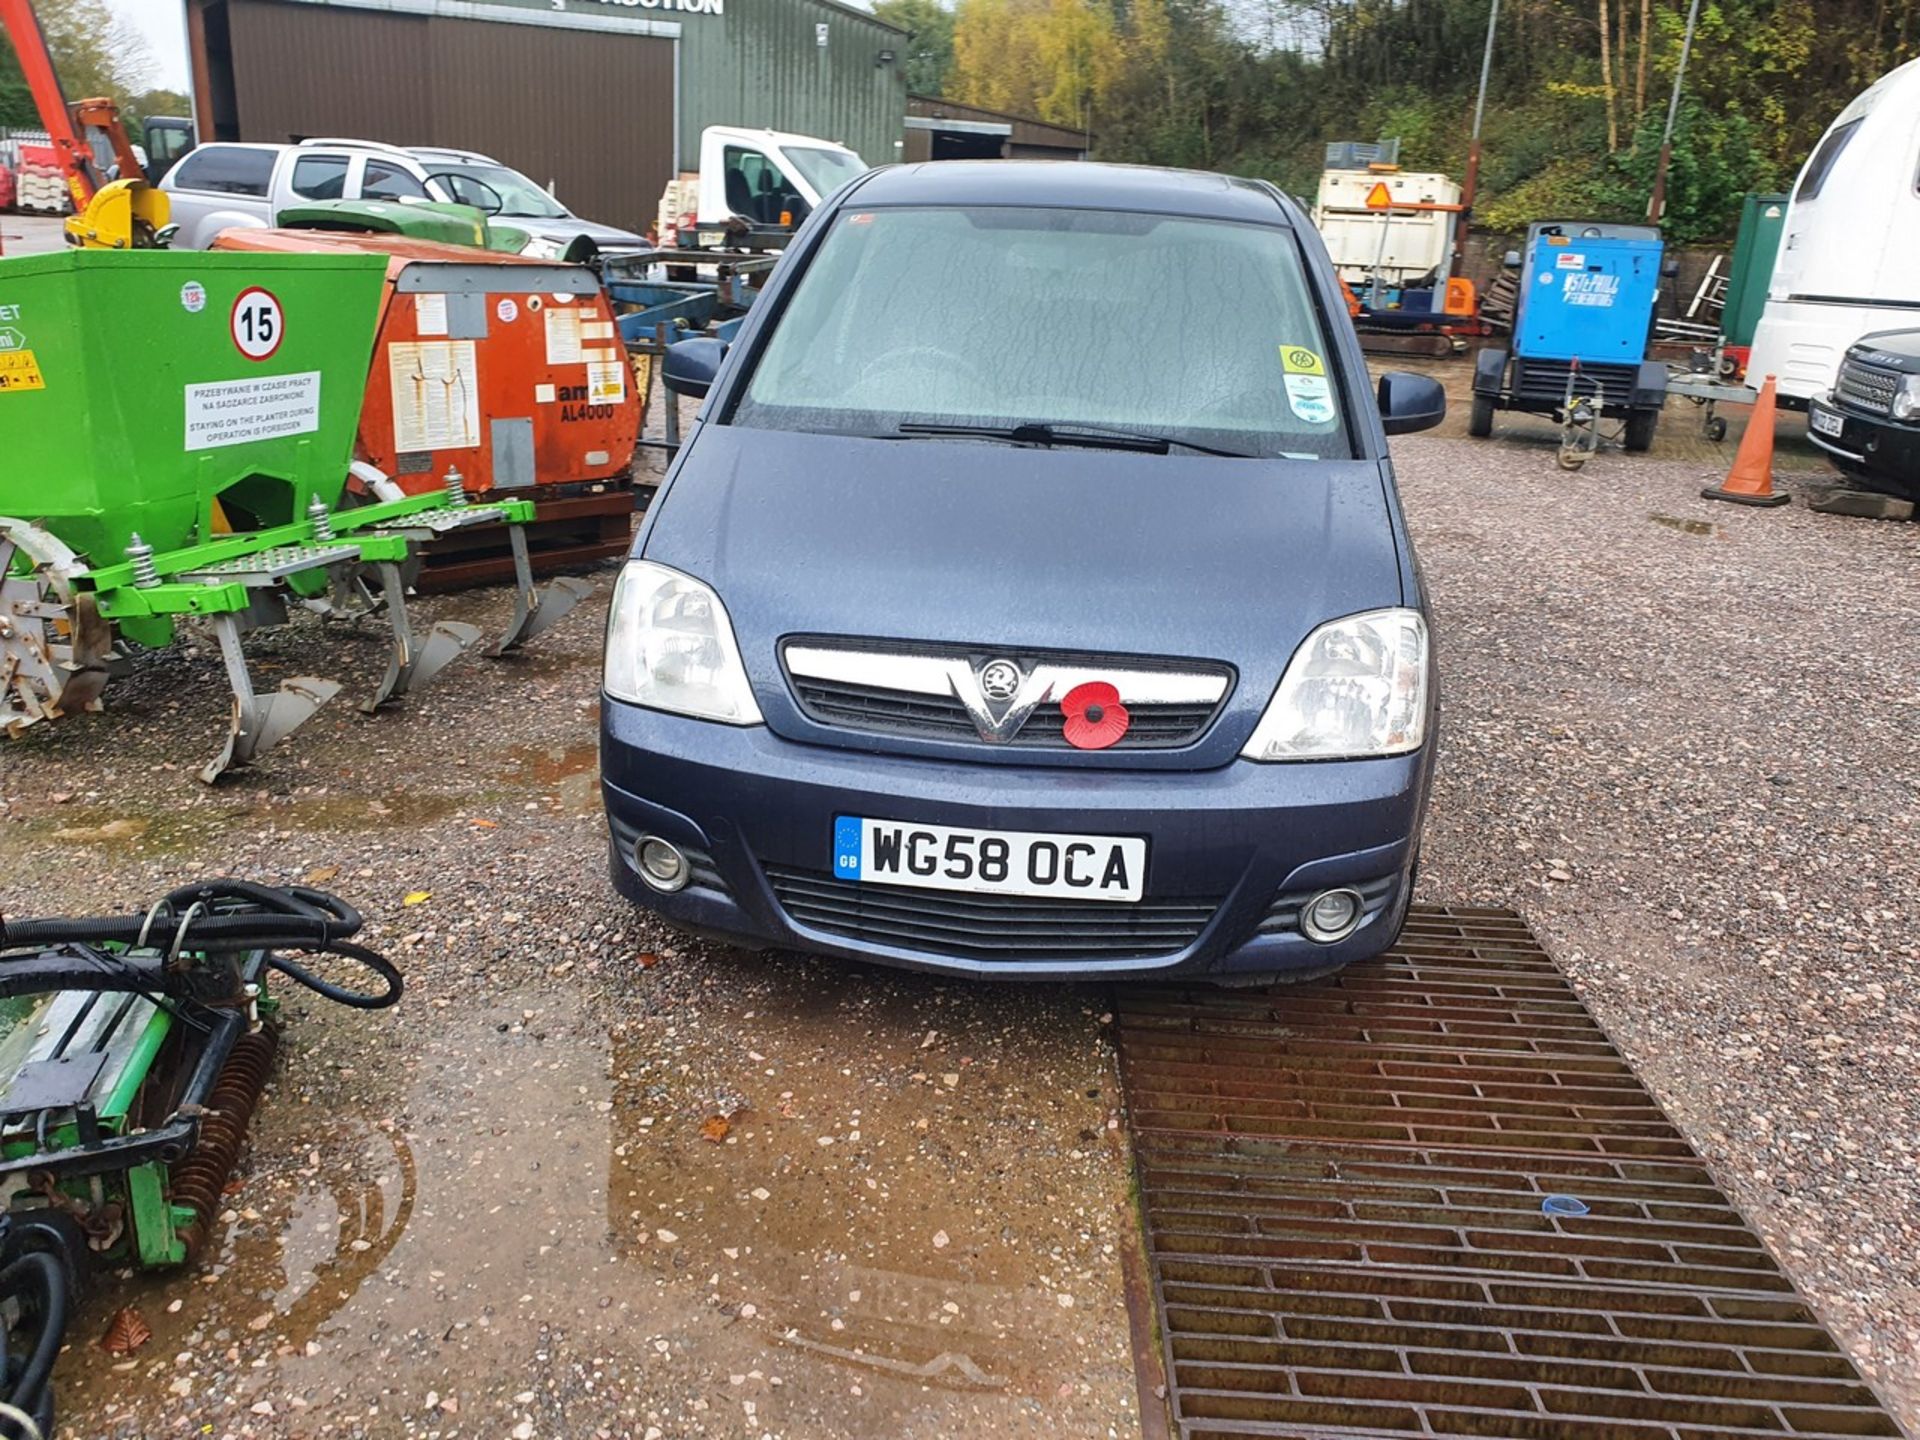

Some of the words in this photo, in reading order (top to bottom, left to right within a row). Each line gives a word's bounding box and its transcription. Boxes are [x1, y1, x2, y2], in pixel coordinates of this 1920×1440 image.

[241, 306, 273, 342] 15
[194, 385, 250, 398] PRZEBYWANIE
[261, 381, 288, 391] CZASIE
[288, 377, 312, 387] PRACY
[202, 402, 214, 411] NA
[560, 404, 614, 422] AL4000
[189, 419, 225, 432] STAYING
[226, 418, 238, 428] ON
[240, 416, 254, 425] THE
[256, 410, 289, 423] PLANTER
[289, 406, 315, 418] DURING
[206, 428, 252, 442] OPERATION
[253, 427, 260, 435] IS
[262, 421, 301, 434] FORBIDDEN
[840, 855, 857, 868] GB
[873, 827, 1010, 883] WG58
[1027, 841, 1130, 891] OCA
